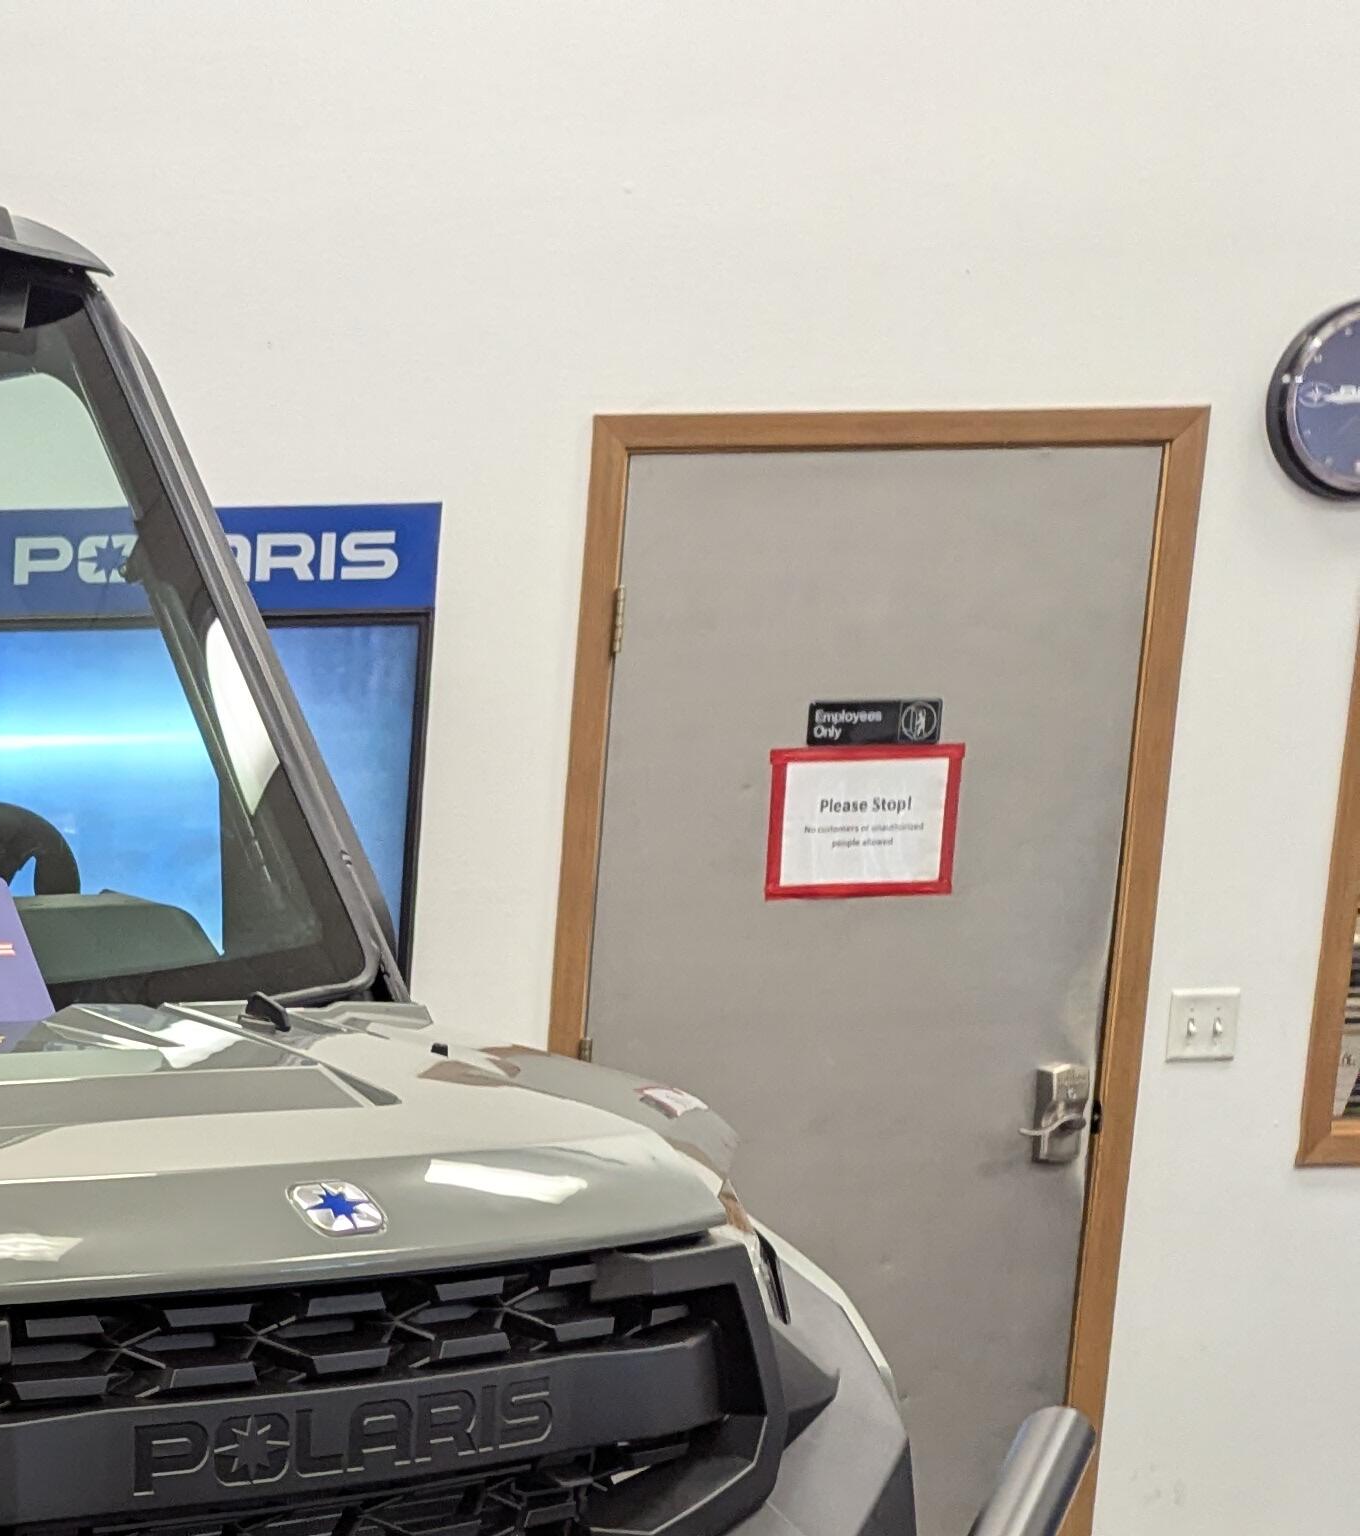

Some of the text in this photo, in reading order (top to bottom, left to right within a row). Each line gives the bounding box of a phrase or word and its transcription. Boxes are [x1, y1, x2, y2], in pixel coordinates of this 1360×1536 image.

[13, 530, 399, 586] PORIS
[815, 709, 882, 724] Employees
[813, 725, 842, 740] Only
[820, 795, 912, 815] Please Stop!
[133, 1376, 553, 1497] POLARIS
